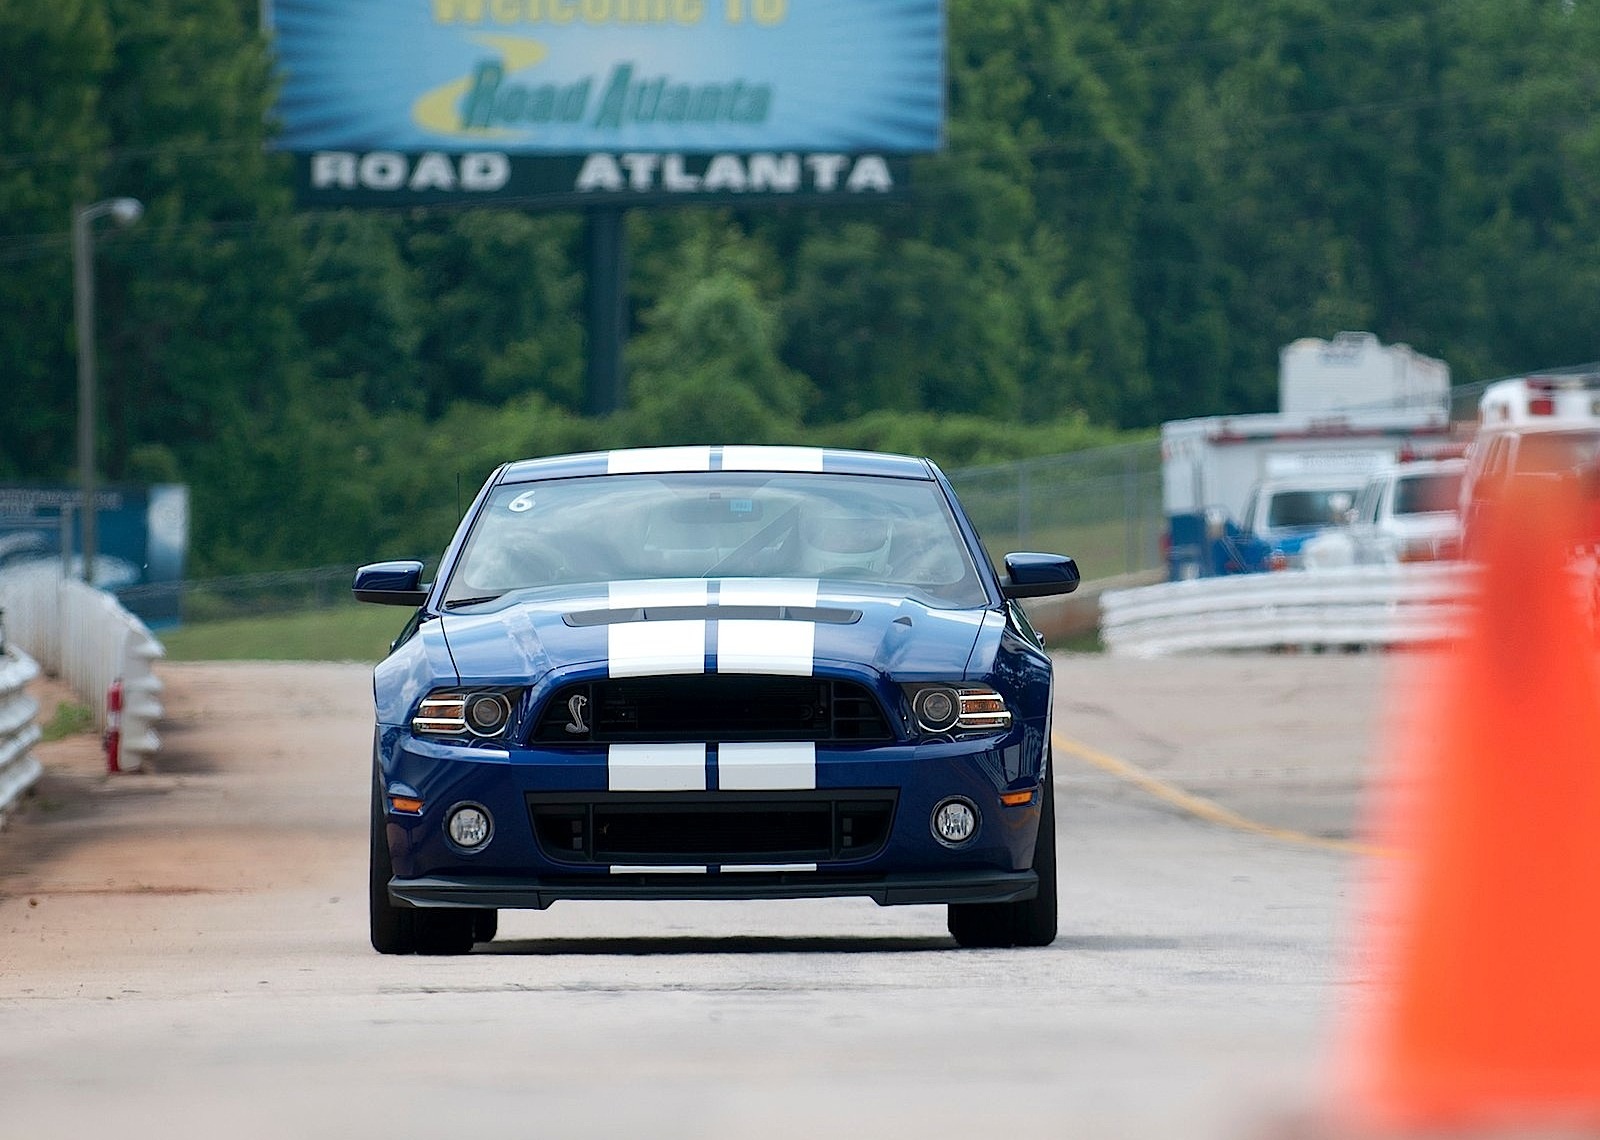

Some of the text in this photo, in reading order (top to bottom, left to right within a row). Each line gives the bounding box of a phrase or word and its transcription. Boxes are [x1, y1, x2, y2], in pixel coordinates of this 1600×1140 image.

[463, 60, 772, 129] Road Atlanta
[311, 152, 894, 193] ROAD ATLANTA
[508, 490, 536, 512] 6
